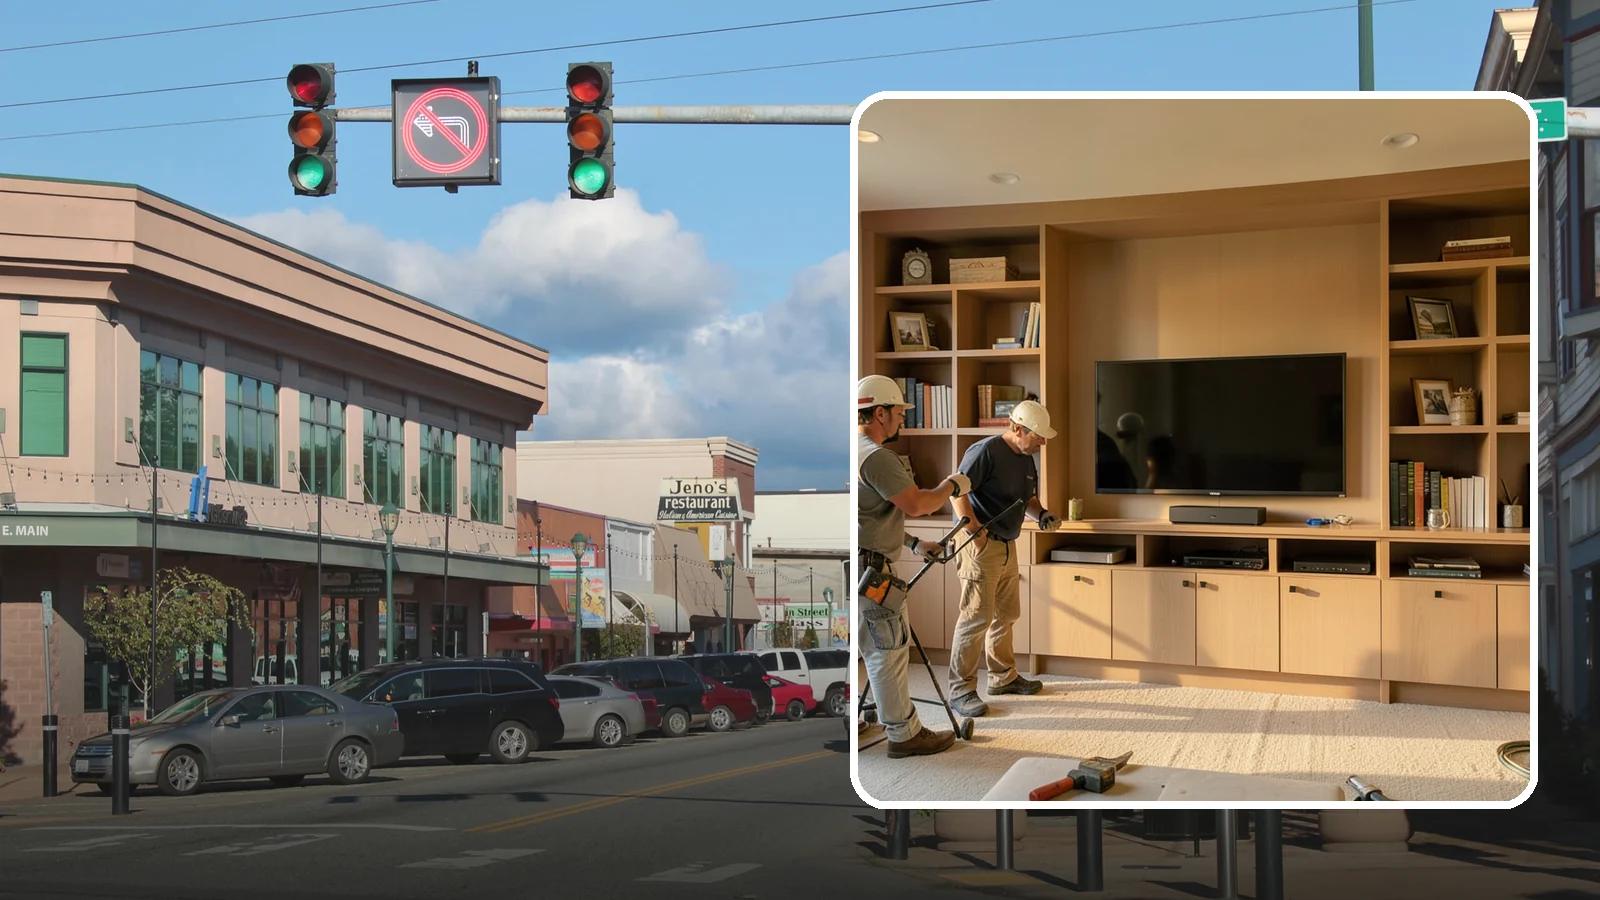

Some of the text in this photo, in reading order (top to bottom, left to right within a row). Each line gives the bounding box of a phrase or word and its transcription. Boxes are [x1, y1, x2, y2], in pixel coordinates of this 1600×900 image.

[669, 480, 727, 494] Jeno's
[665, 496, 731, 509] restaurant
[686, 509, 714, 519] American
[715, 509, 737, 519] Cuisine
[2, 525, 49, 536] E. MAIN
[797, 607, 828, 617] Street
